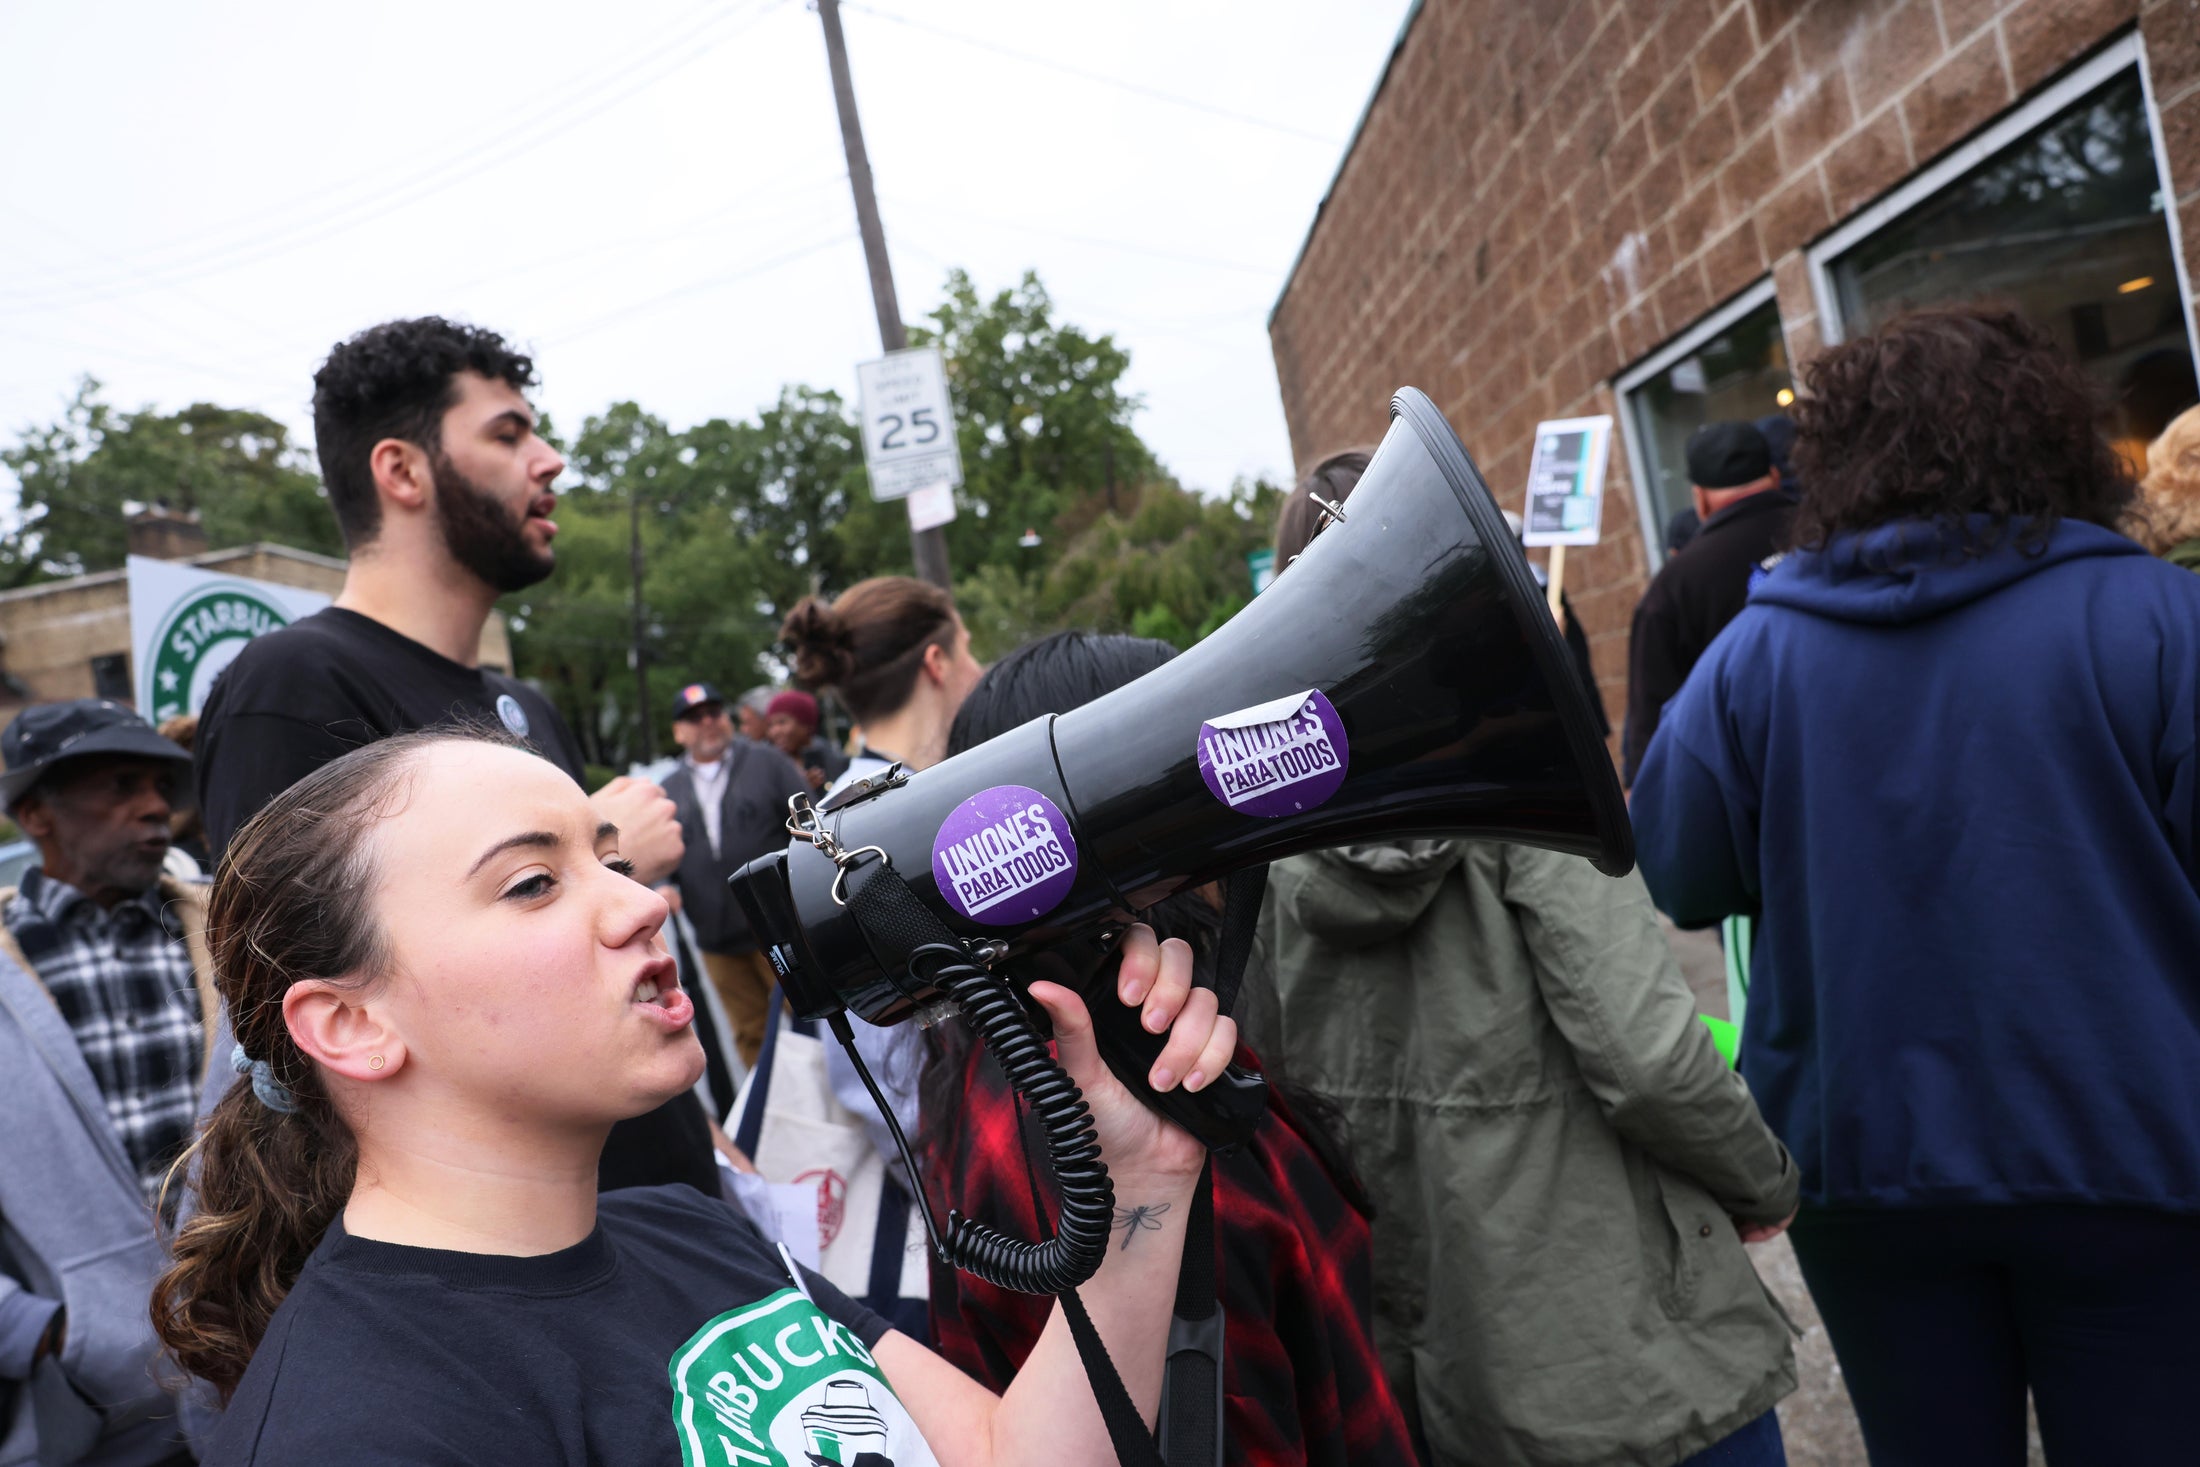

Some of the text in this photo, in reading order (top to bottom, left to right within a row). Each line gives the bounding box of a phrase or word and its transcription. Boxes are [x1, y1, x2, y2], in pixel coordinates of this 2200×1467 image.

[878, 408, 940, 450] 25
[1222, 738, 1336, 794] PARA TODOS
[939, 803, 1052, 881] UNIONES
[959, 839, 1066, 903] PARA TODOS
[769, 949, 785, 976] VOLUME
